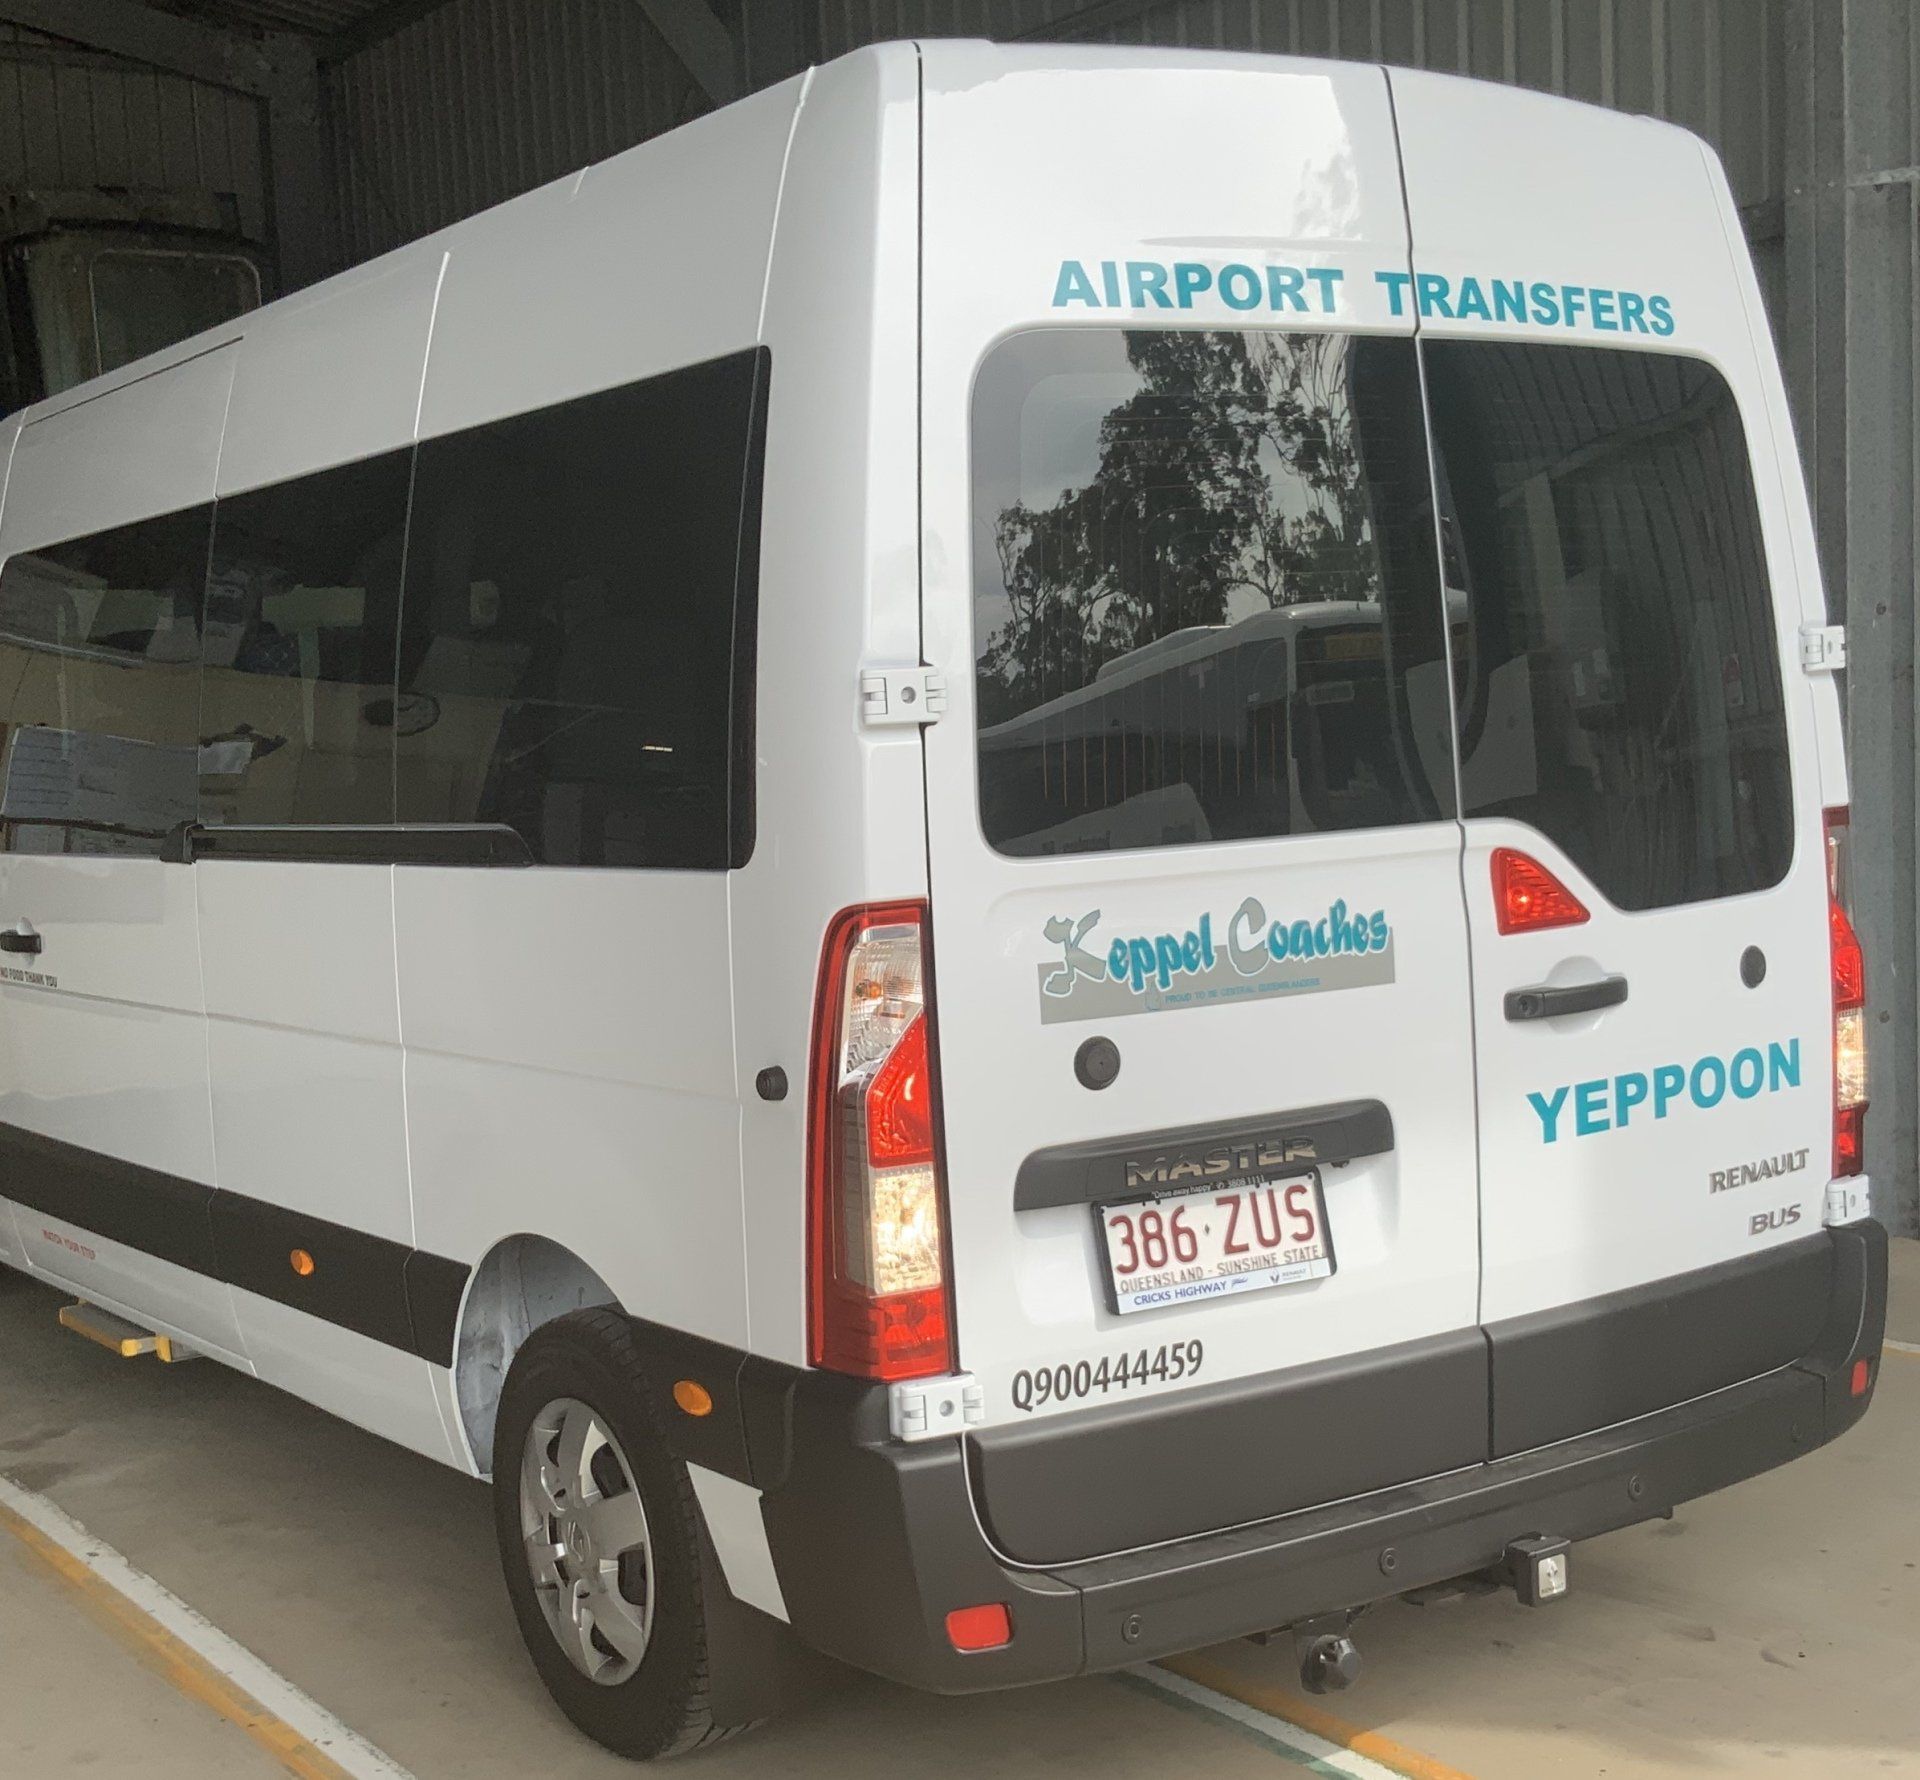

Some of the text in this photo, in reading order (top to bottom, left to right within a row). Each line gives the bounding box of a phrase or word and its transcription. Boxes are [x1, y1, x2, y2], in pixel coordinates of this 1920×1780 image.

[1051, 260, 1675, 337] AIRPORT TRANSFERS
[1043, 896, 1391, 996] Keppel Coaches
[25, 970, 44, 985] THANK
[45, 974, 58, 988] YOU
[1526, 1037, 1801, 1144] YEPPOON
[1126, 1135, 1317, 1187] MASTER
[1709, 1148, 1810, 1194] RENAULT
[1748, 1204, 1802, 1236] BUS
[1120, 1266, 1203, 1294] QUEENSLAND
[1216, 1255, 1278, 1276] SUNSHINE
[1284, 1245, 1319, 1263] STATE
[1133, 1290, 1171, 1306] CRICKS
[1175, 1281, 1228, 1299] HIGHWAY
[1011, 1339, 1204, 1412] Q900444459
